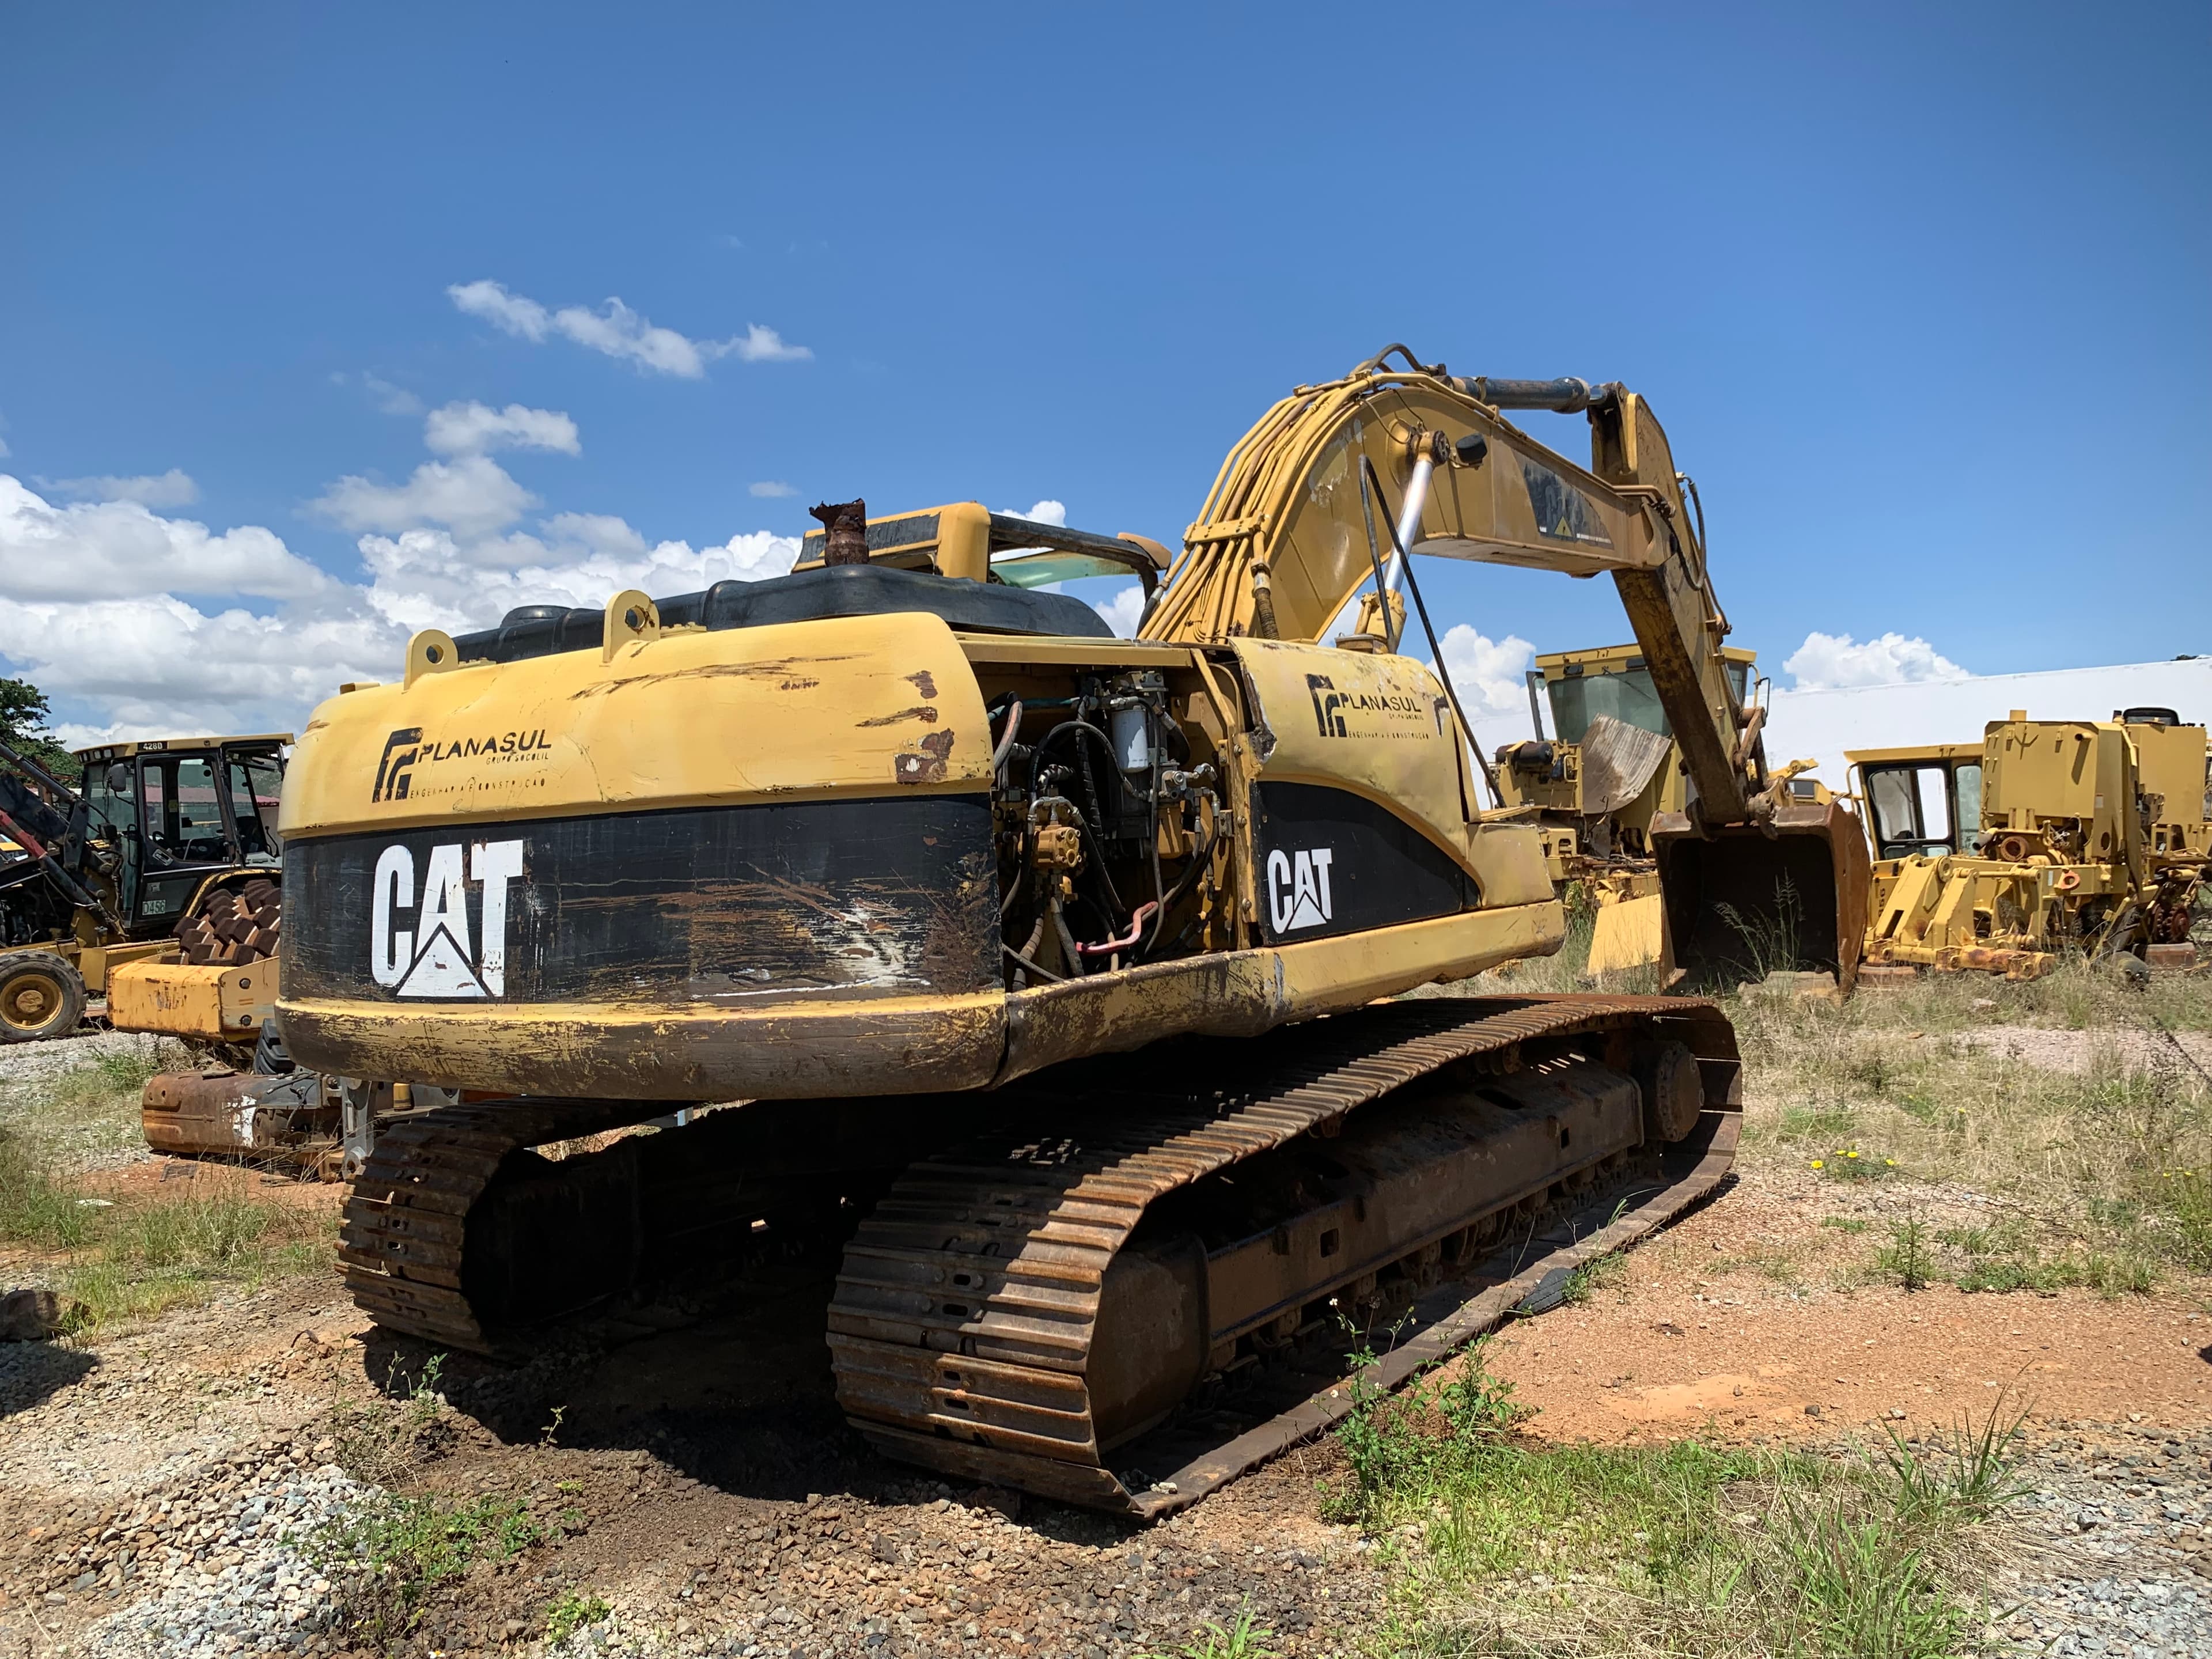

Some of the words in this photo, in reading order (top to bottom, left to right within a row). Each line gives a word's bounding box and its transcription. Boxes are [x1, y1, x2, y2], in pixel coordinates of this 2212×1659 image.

[1339, 692, 1422, 713] PLANASUL
[143, 742, 162, 750] 428D
[418, 729, 552, 763] PLANASUL
[515, 752, 549, 762] SOCOLIL
[1267, 848, 1332, 934] CAT
[143, 900, 165, 915] D456
[372, 839, 524, 997] CAT
